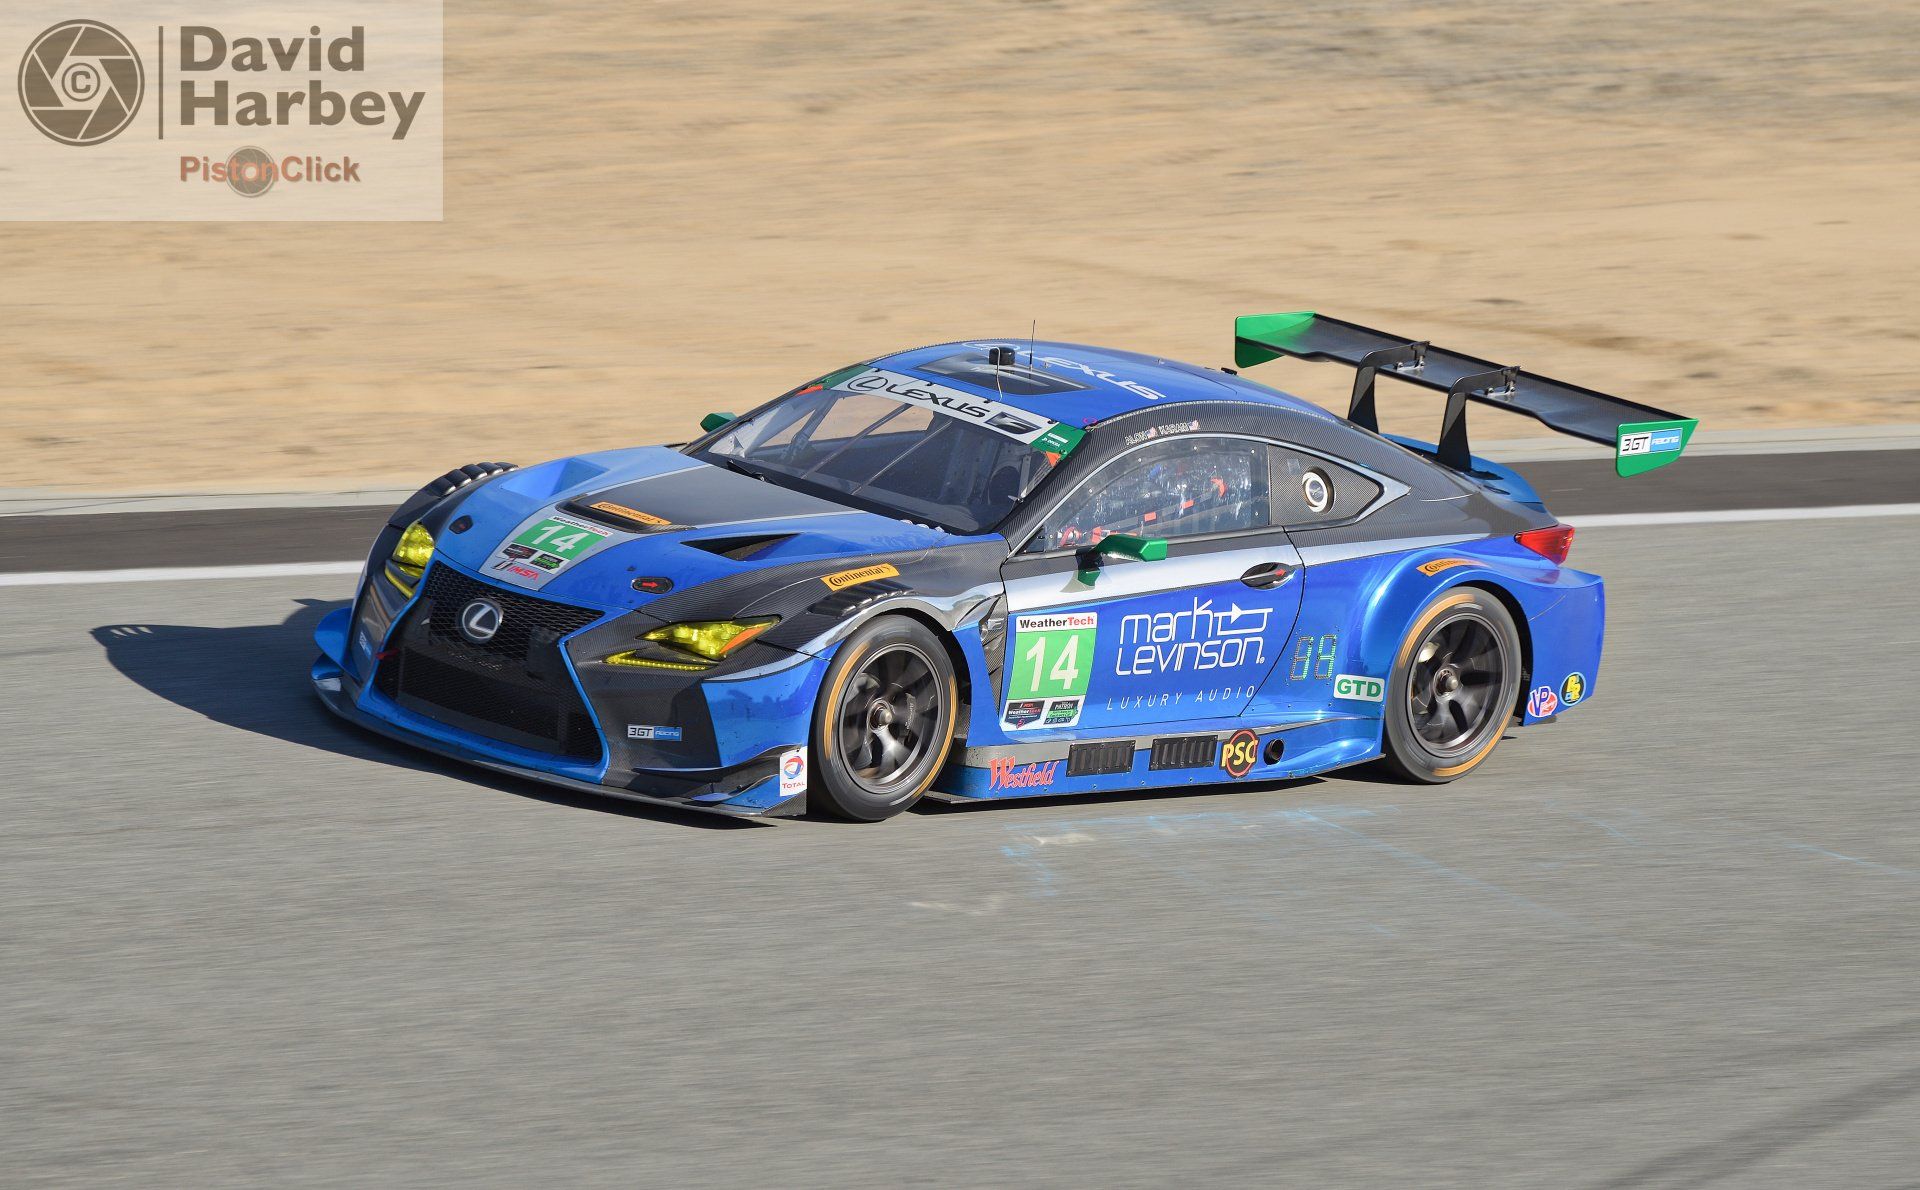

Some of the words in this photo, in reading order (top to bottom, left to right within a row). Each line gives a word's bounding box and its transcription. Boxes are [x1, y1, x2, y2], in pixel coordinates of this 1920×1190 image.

[884, 384, 990, 418] LEXUS
[1622, 436, 1649, 452] 3GT
[531, 525, 590, 552] 14
[553, 516, 609, 536] WeatherTech
[828, 566, 884, 587] Continental
[1020, 616, 1094, 628] WeatherTech
[1120, 596, 1213, 644] mark
[1026, 634, 1079, 692] 14
[1106, 692, 1184, 711] LUXURY
[1194, 685, 1256, 703] AUDIO
[1336, 677, 1382, 697] GTD
[629, 727, 653, 737] 3GT
[1221, 740, 1258, 767] PSC
[988, 755, 1059, 791] Westfield
